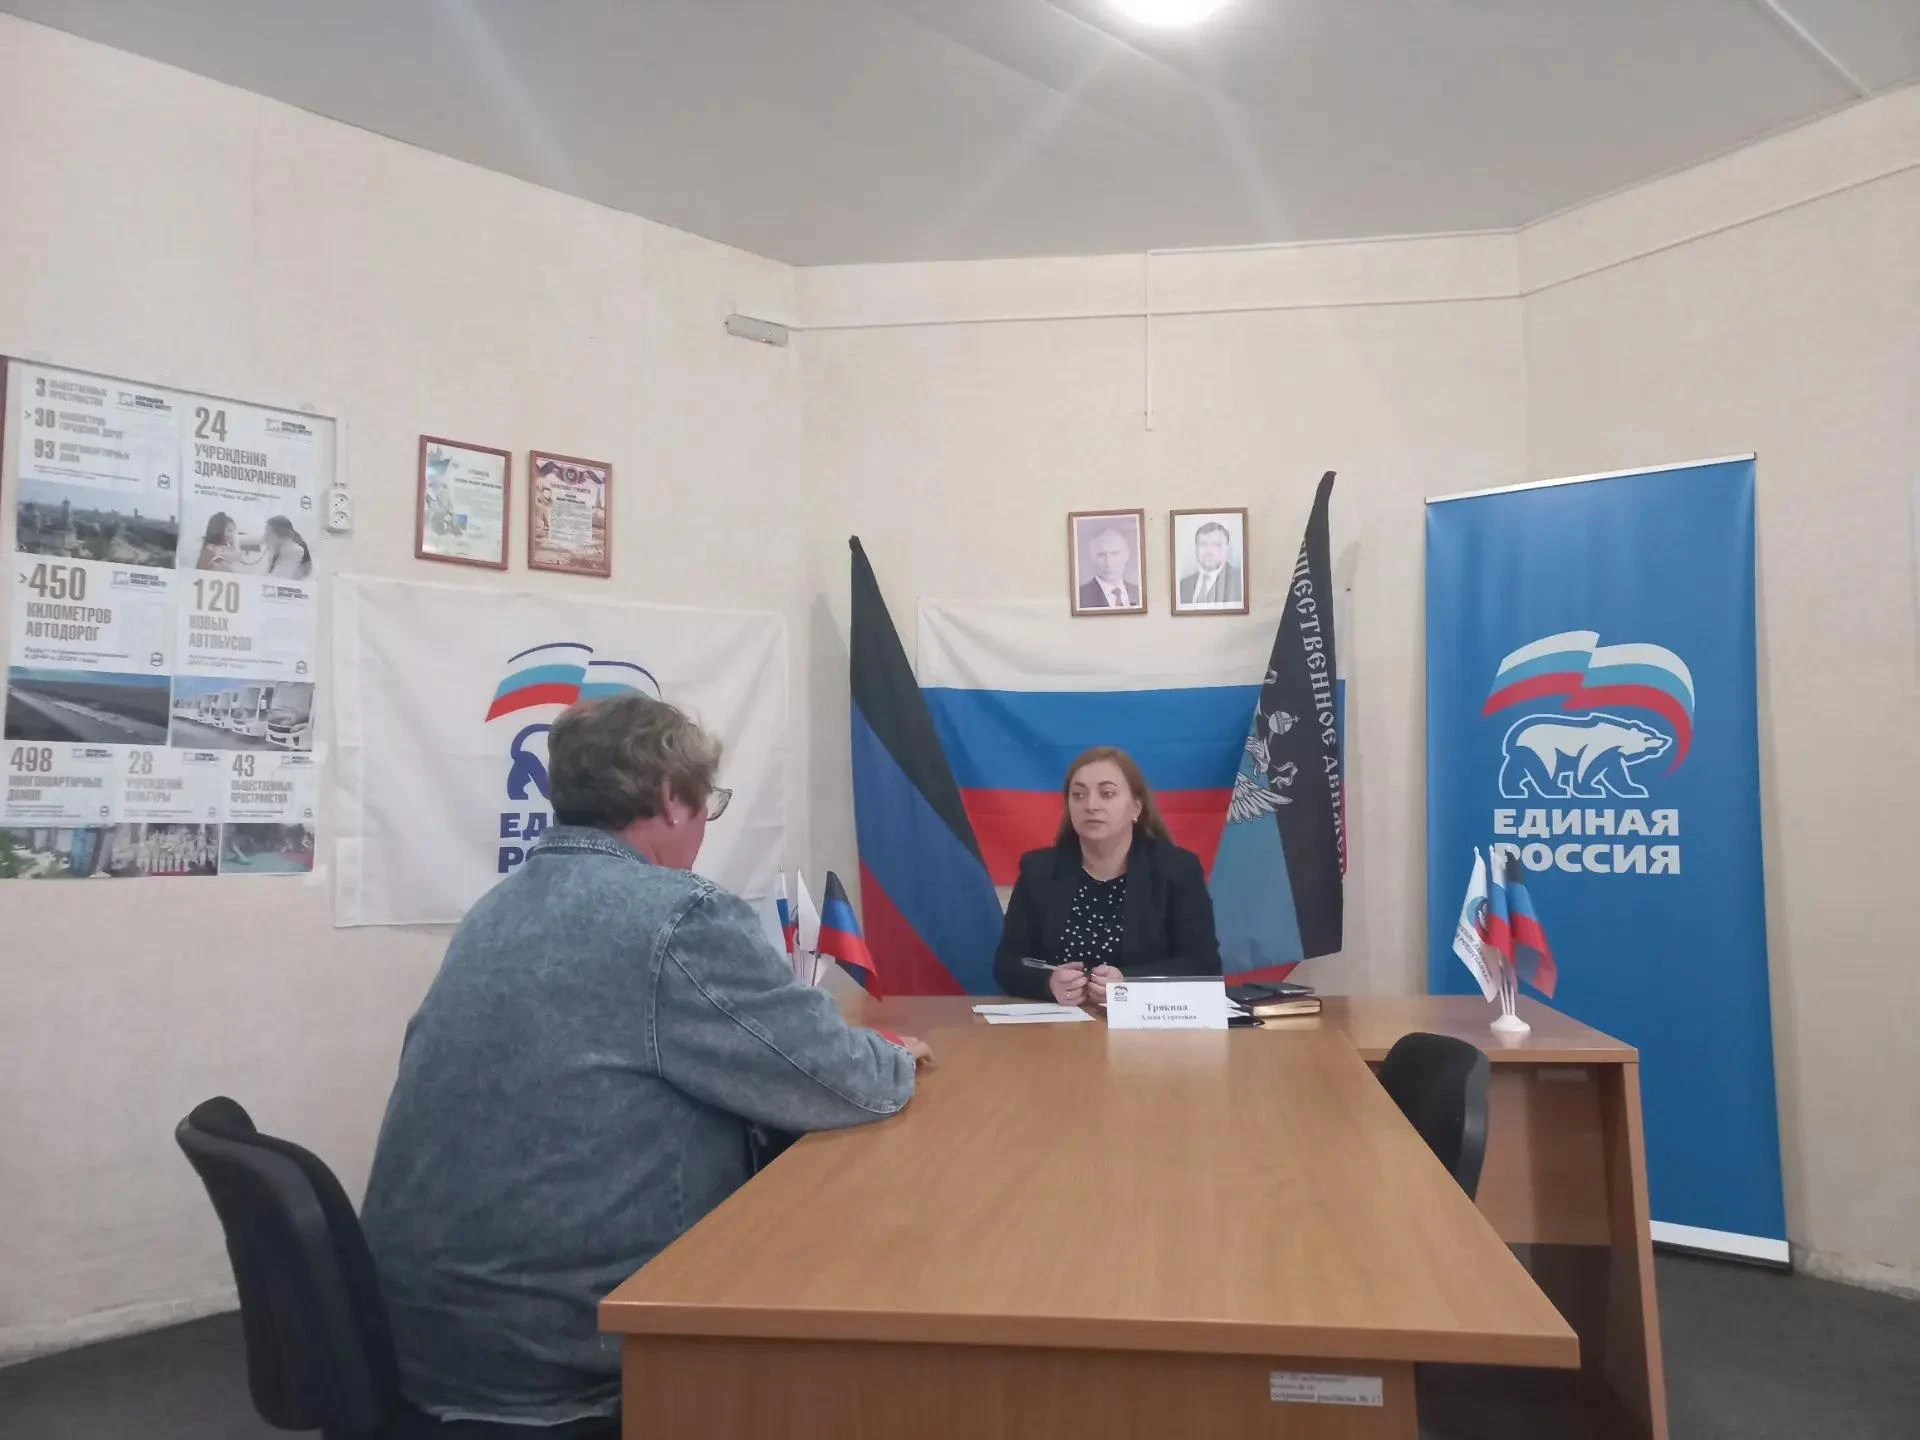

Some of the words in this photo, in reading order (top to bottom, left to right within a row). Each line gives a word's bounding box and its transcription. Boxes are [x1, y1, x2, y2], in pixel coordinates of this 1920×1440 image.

[35, 377, 46, 397] 3
[195, 406, 228, 442] 24
[34, 438, 55, 459] 93
[194, 442, 267, 467] УЧРЕЖДЕНИЯ
[194, 460, 297, 488] ЗДРАВООХРАНЕНИЯ
[193, 578, 240, 613] 120
[26, 601, 112, 624] КИЛОМЕТРОВ
[188, 614, 229, 631] НОВЫХ
[25, 620, 100, 641] АВТОДОРОГ
[188, 632, 252, 651] АВТОБУСОВ
[9, 747, 53, 772] 498
[128, 750, 153, 775] 28
[232, 754, 255, 777] 43
[1493, 808, 1680, 838] ЕДИНАЯ
[1145, 1003, 1189, 1013] Трякина
